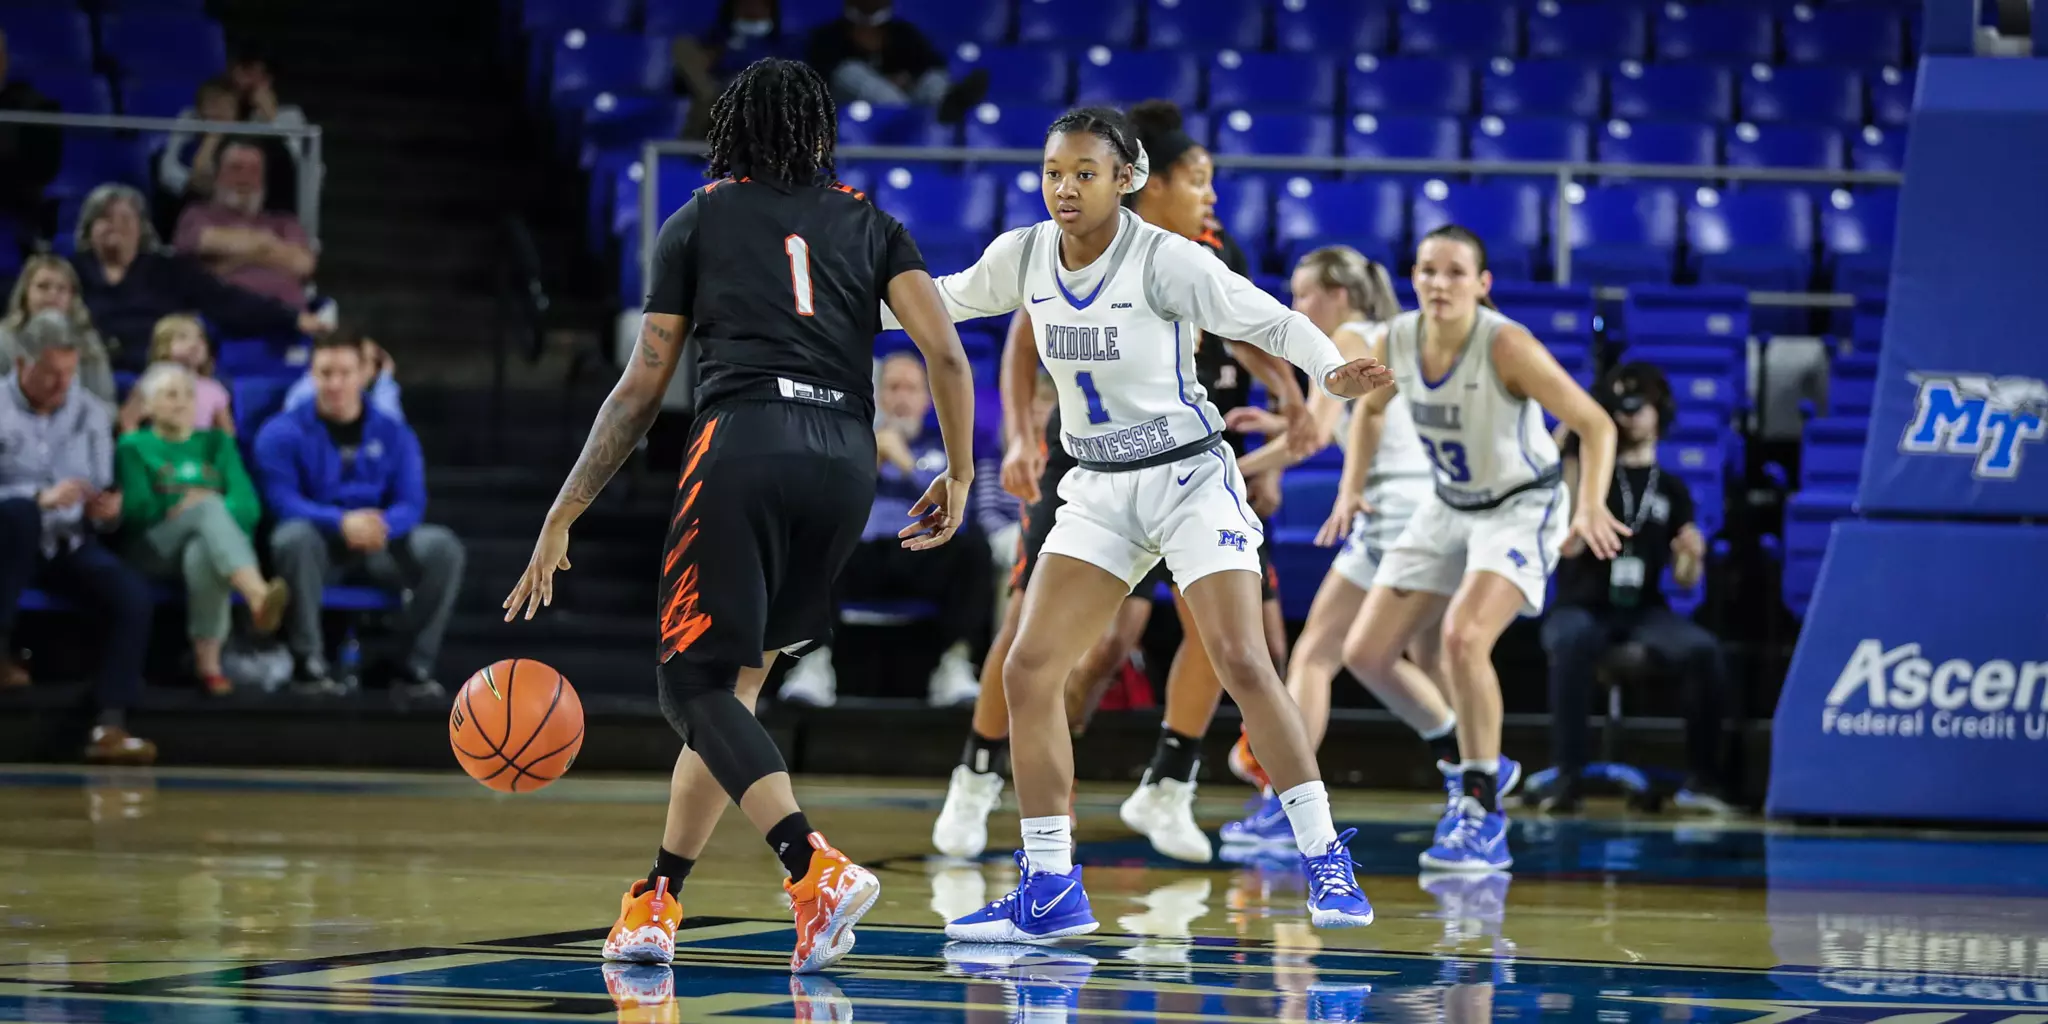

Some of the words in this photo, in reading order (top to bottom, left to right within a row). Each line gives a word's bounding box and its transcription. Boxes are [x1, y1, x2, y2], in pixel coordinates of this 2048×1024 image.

[784, 233, 815, 316] 1
[1045, 323, 1121, 361] MIDDLE
[1074, 370, 1112, 425] 1
[1065, 415, 1176, 462] TENNESSEE
[1903, 376, 2046, 479] MT
[1217, 530, 1247, 552] MT
[1826, 639, 2048, 712] Ascen
[1822, 708, 1924, 737] Federal
[1931, 711, 2016, 740] Credit
